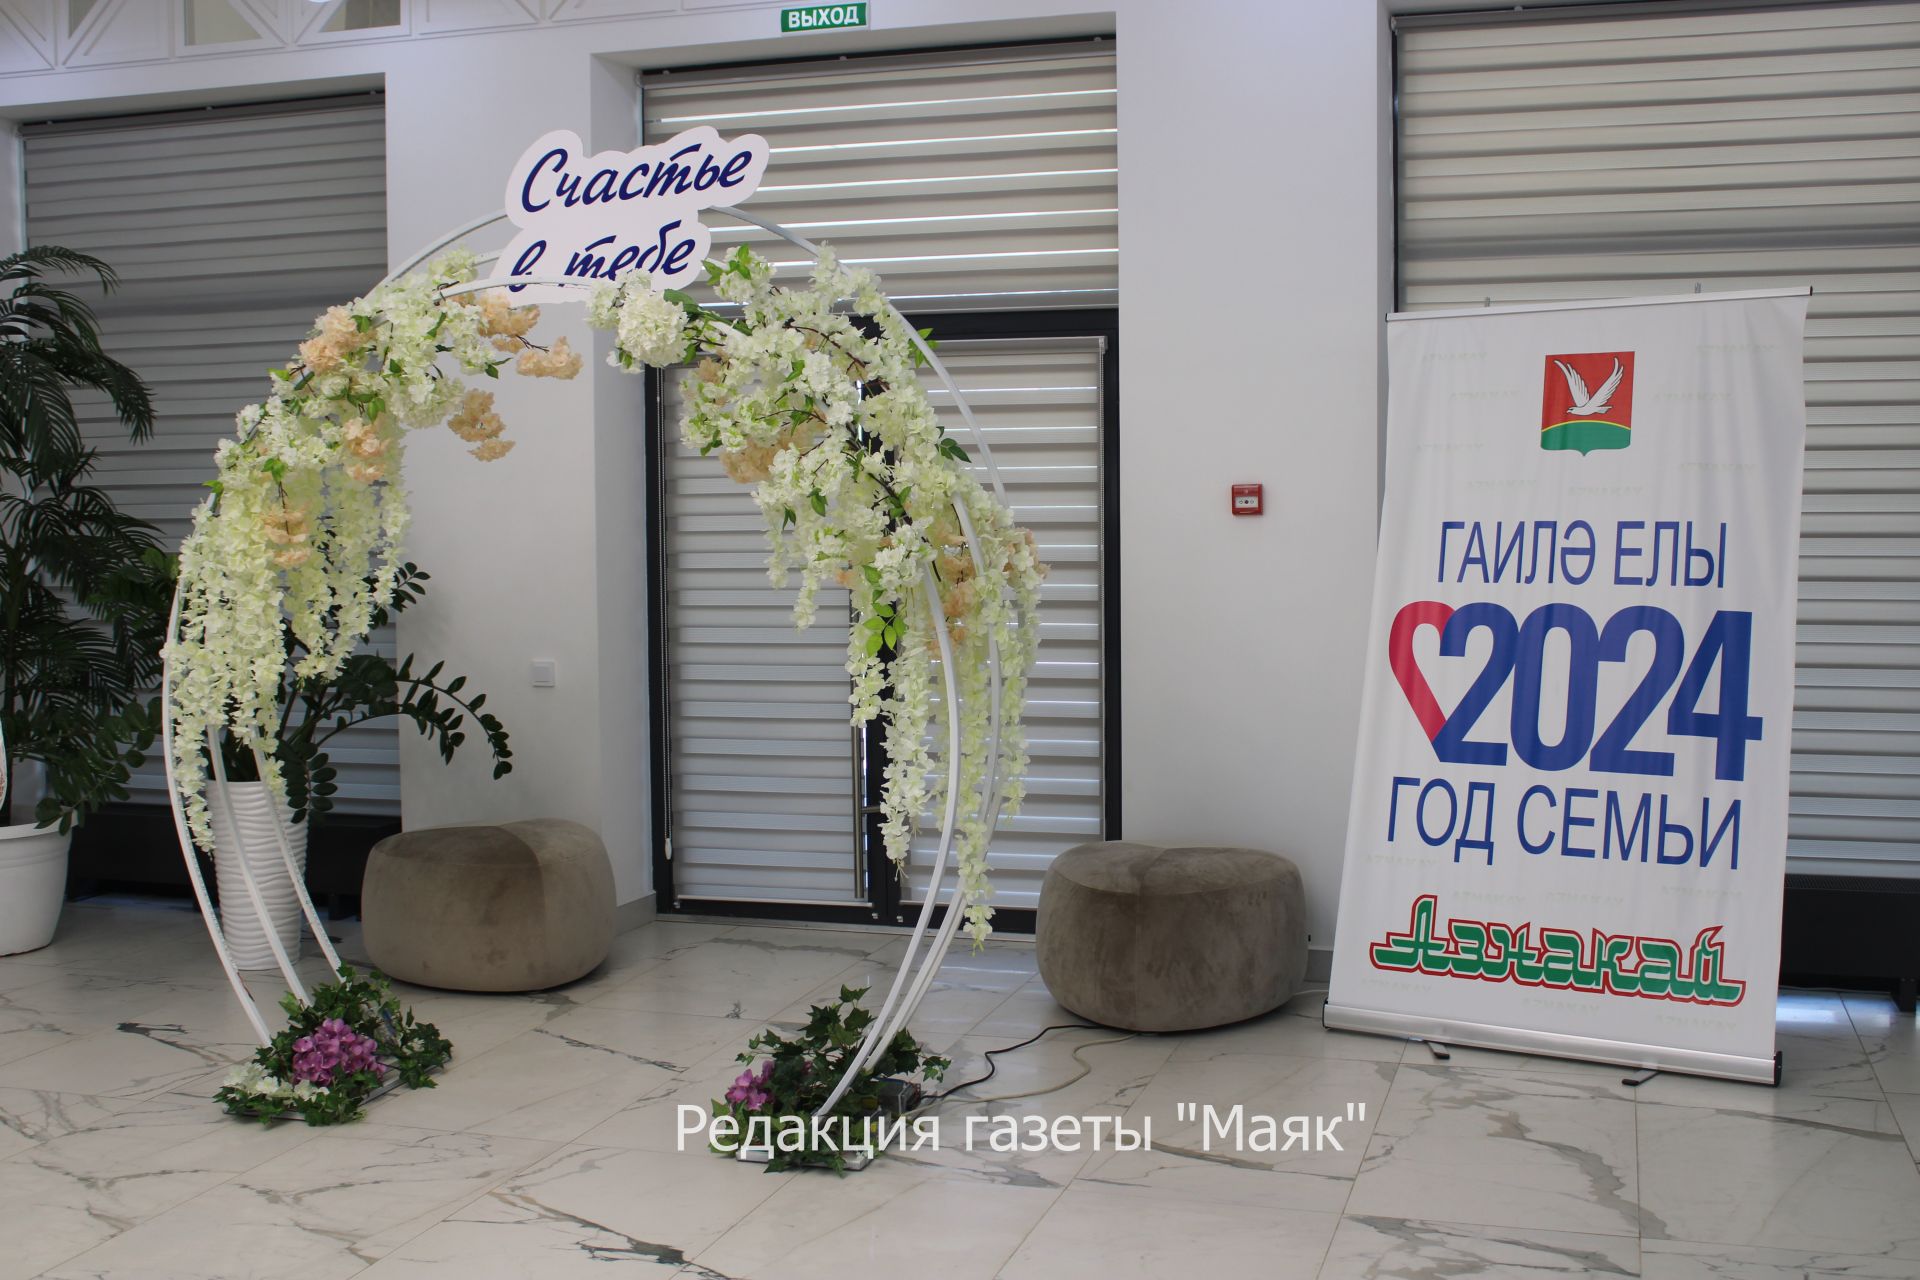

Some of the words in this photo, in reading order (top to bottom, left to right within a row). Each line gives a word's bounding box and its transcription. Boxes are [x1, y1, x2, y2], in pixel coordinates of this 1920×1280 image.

[788, 5, 860, 29] ВЫХОД
[521, 143, 753, 213] Счастье
[508, 239, 547, 293] в
[558, 219, 696, 287] тебе
[1437, 519, 1596, 586] ГАИЛӘ
[1613, 520, 1727, 589] ЕЛЫ
[1431, 601, 1764, 782] 2024
[1387, 776, 1495, 866] ГОД
[1516, 784, 1742, 871] СЕМЬИ
